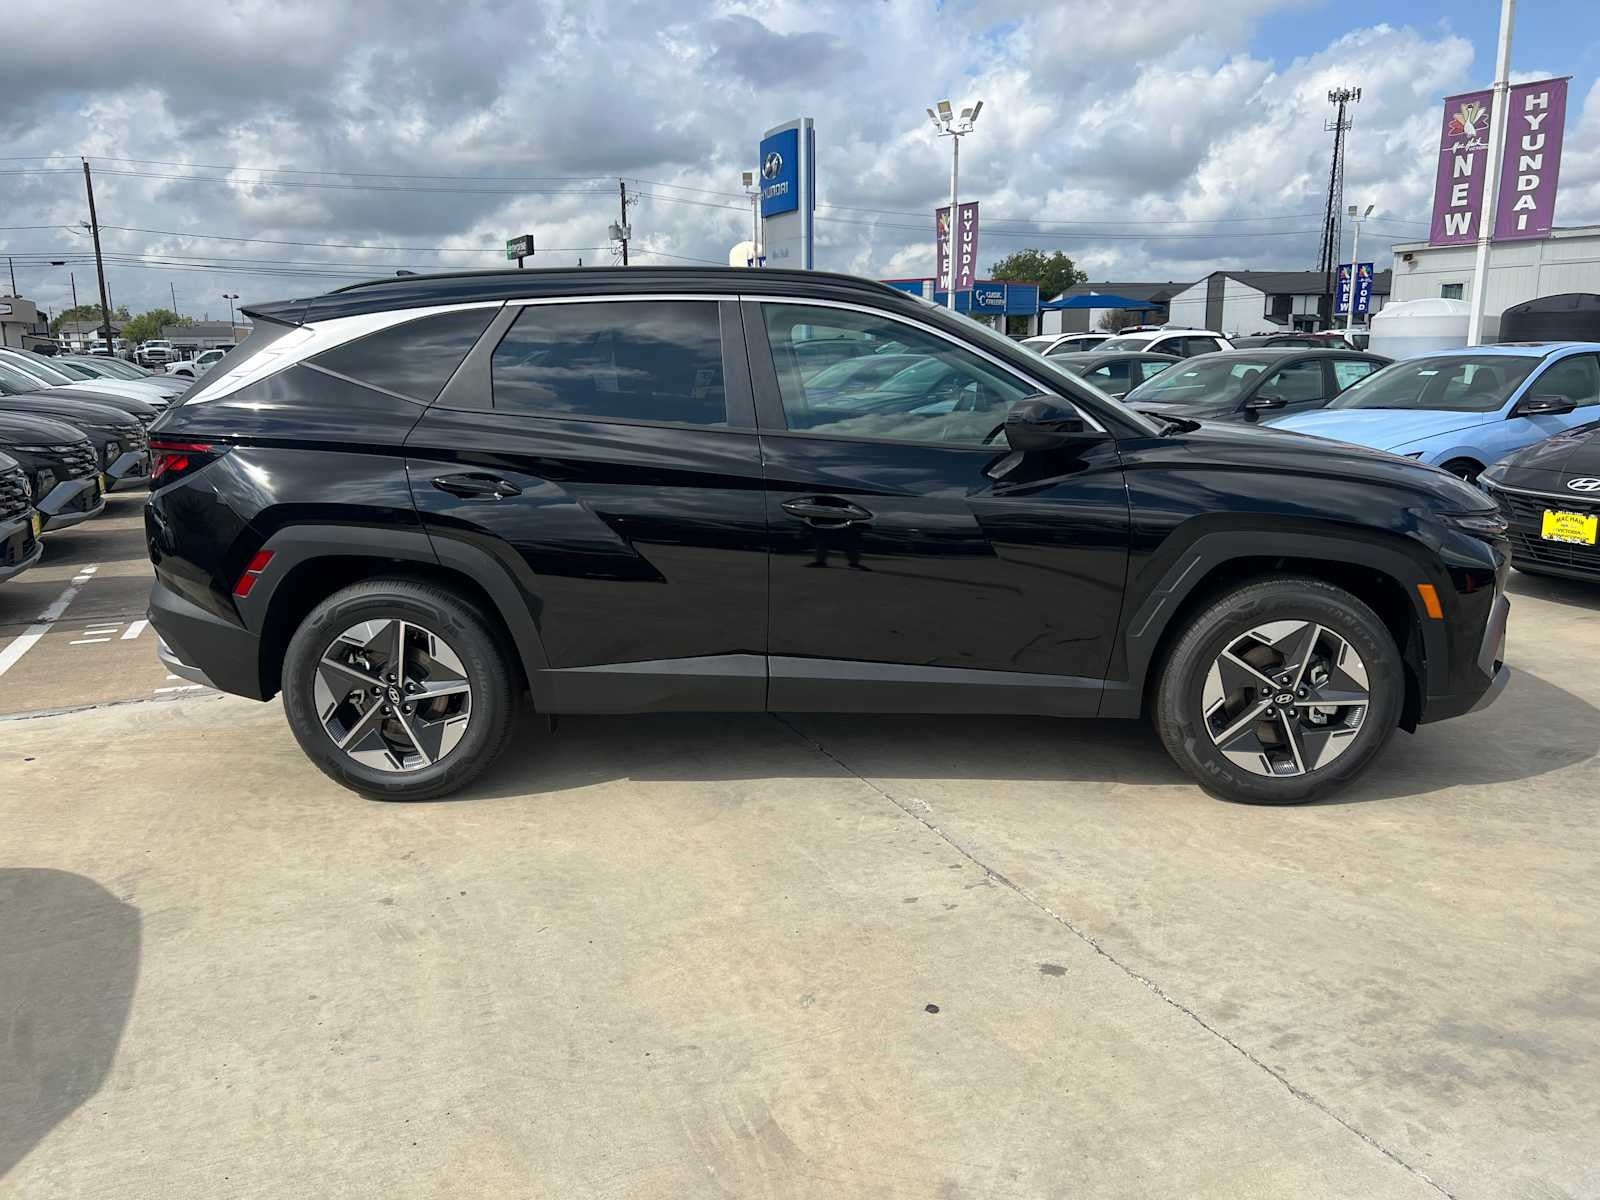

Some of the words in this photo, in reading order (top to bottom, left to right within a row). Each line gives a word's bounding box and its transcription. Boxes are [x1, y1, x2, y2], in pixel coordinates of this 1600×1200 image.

[1512, 92, 1550, 230] HYUNDAI
[761, 181, 789, 200] HYUNDAI
[1444, 153, 1473, 236] NEW
[941, 242, 950, 289] NEW
[962, 208, 973, 286] HYUNDAI
[1341, 284, 1350, 311] NEW
[1358, 282, 1368, 309] FORD
